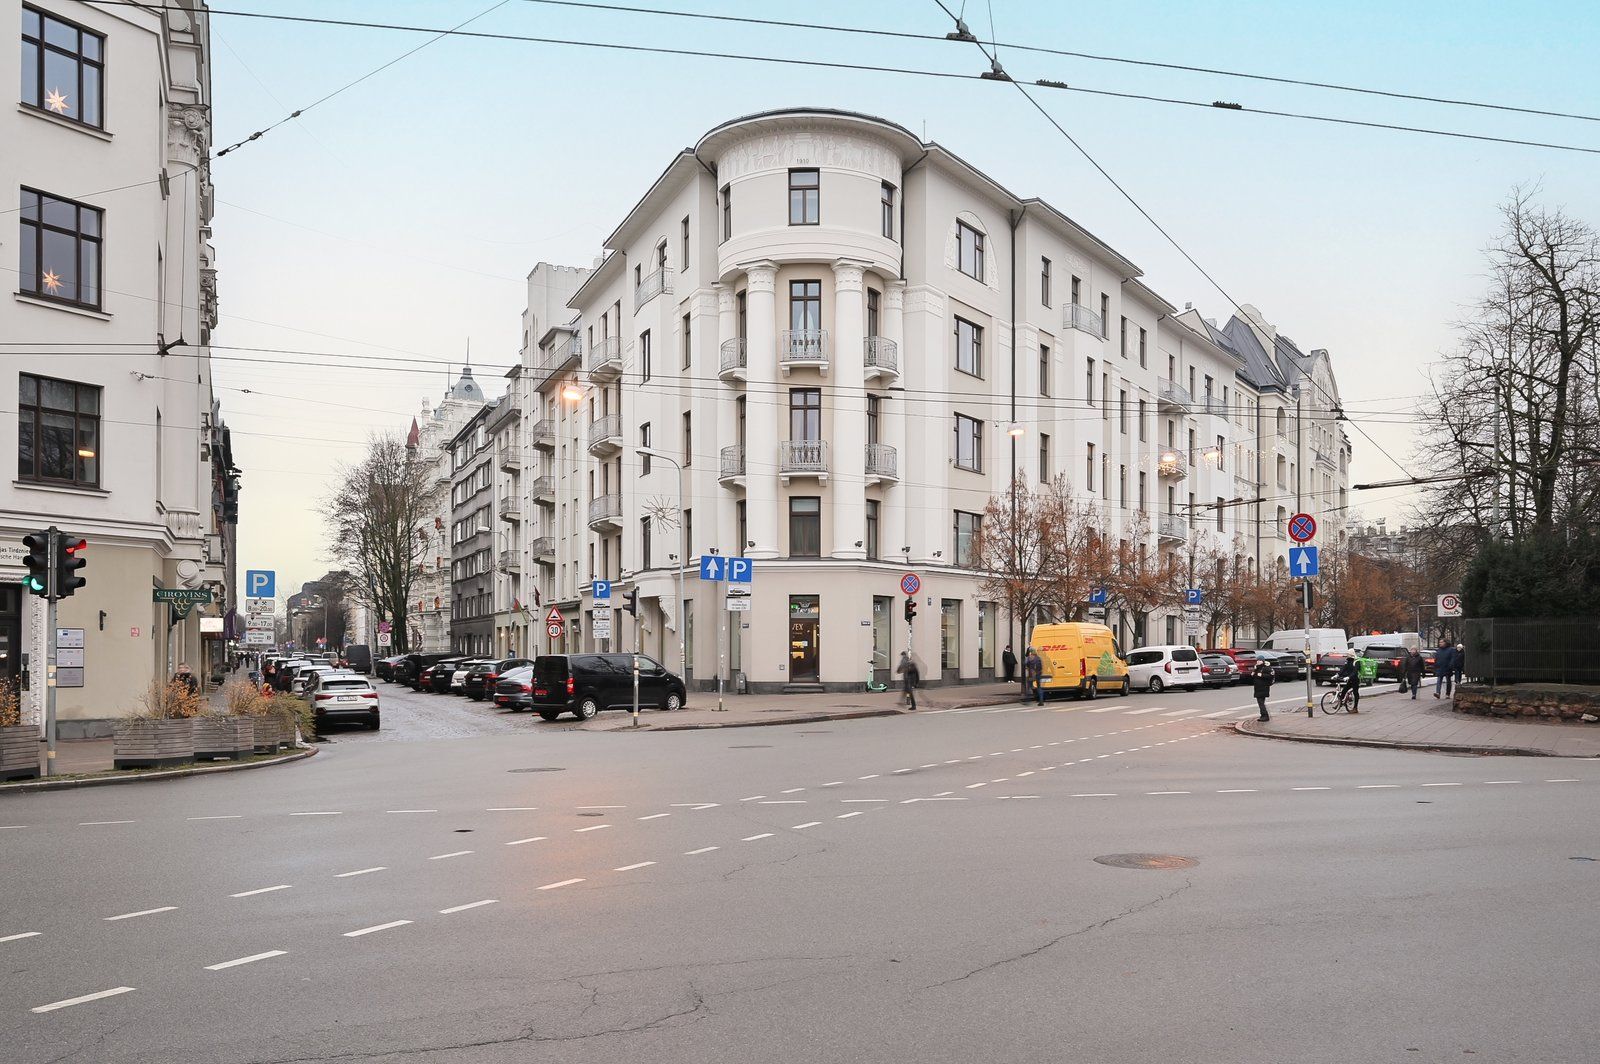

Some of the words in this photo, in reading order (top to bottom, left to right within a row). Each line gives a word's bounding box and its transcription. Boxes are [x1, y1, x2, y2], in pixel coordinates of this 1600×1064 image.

[733, 560, 747, 579] P
[253, 573, 269, 594] P
[596, 582, 606, 596] P
[1445, 598, 1454, 606] 30
[550, 626, 559, 637] 30
